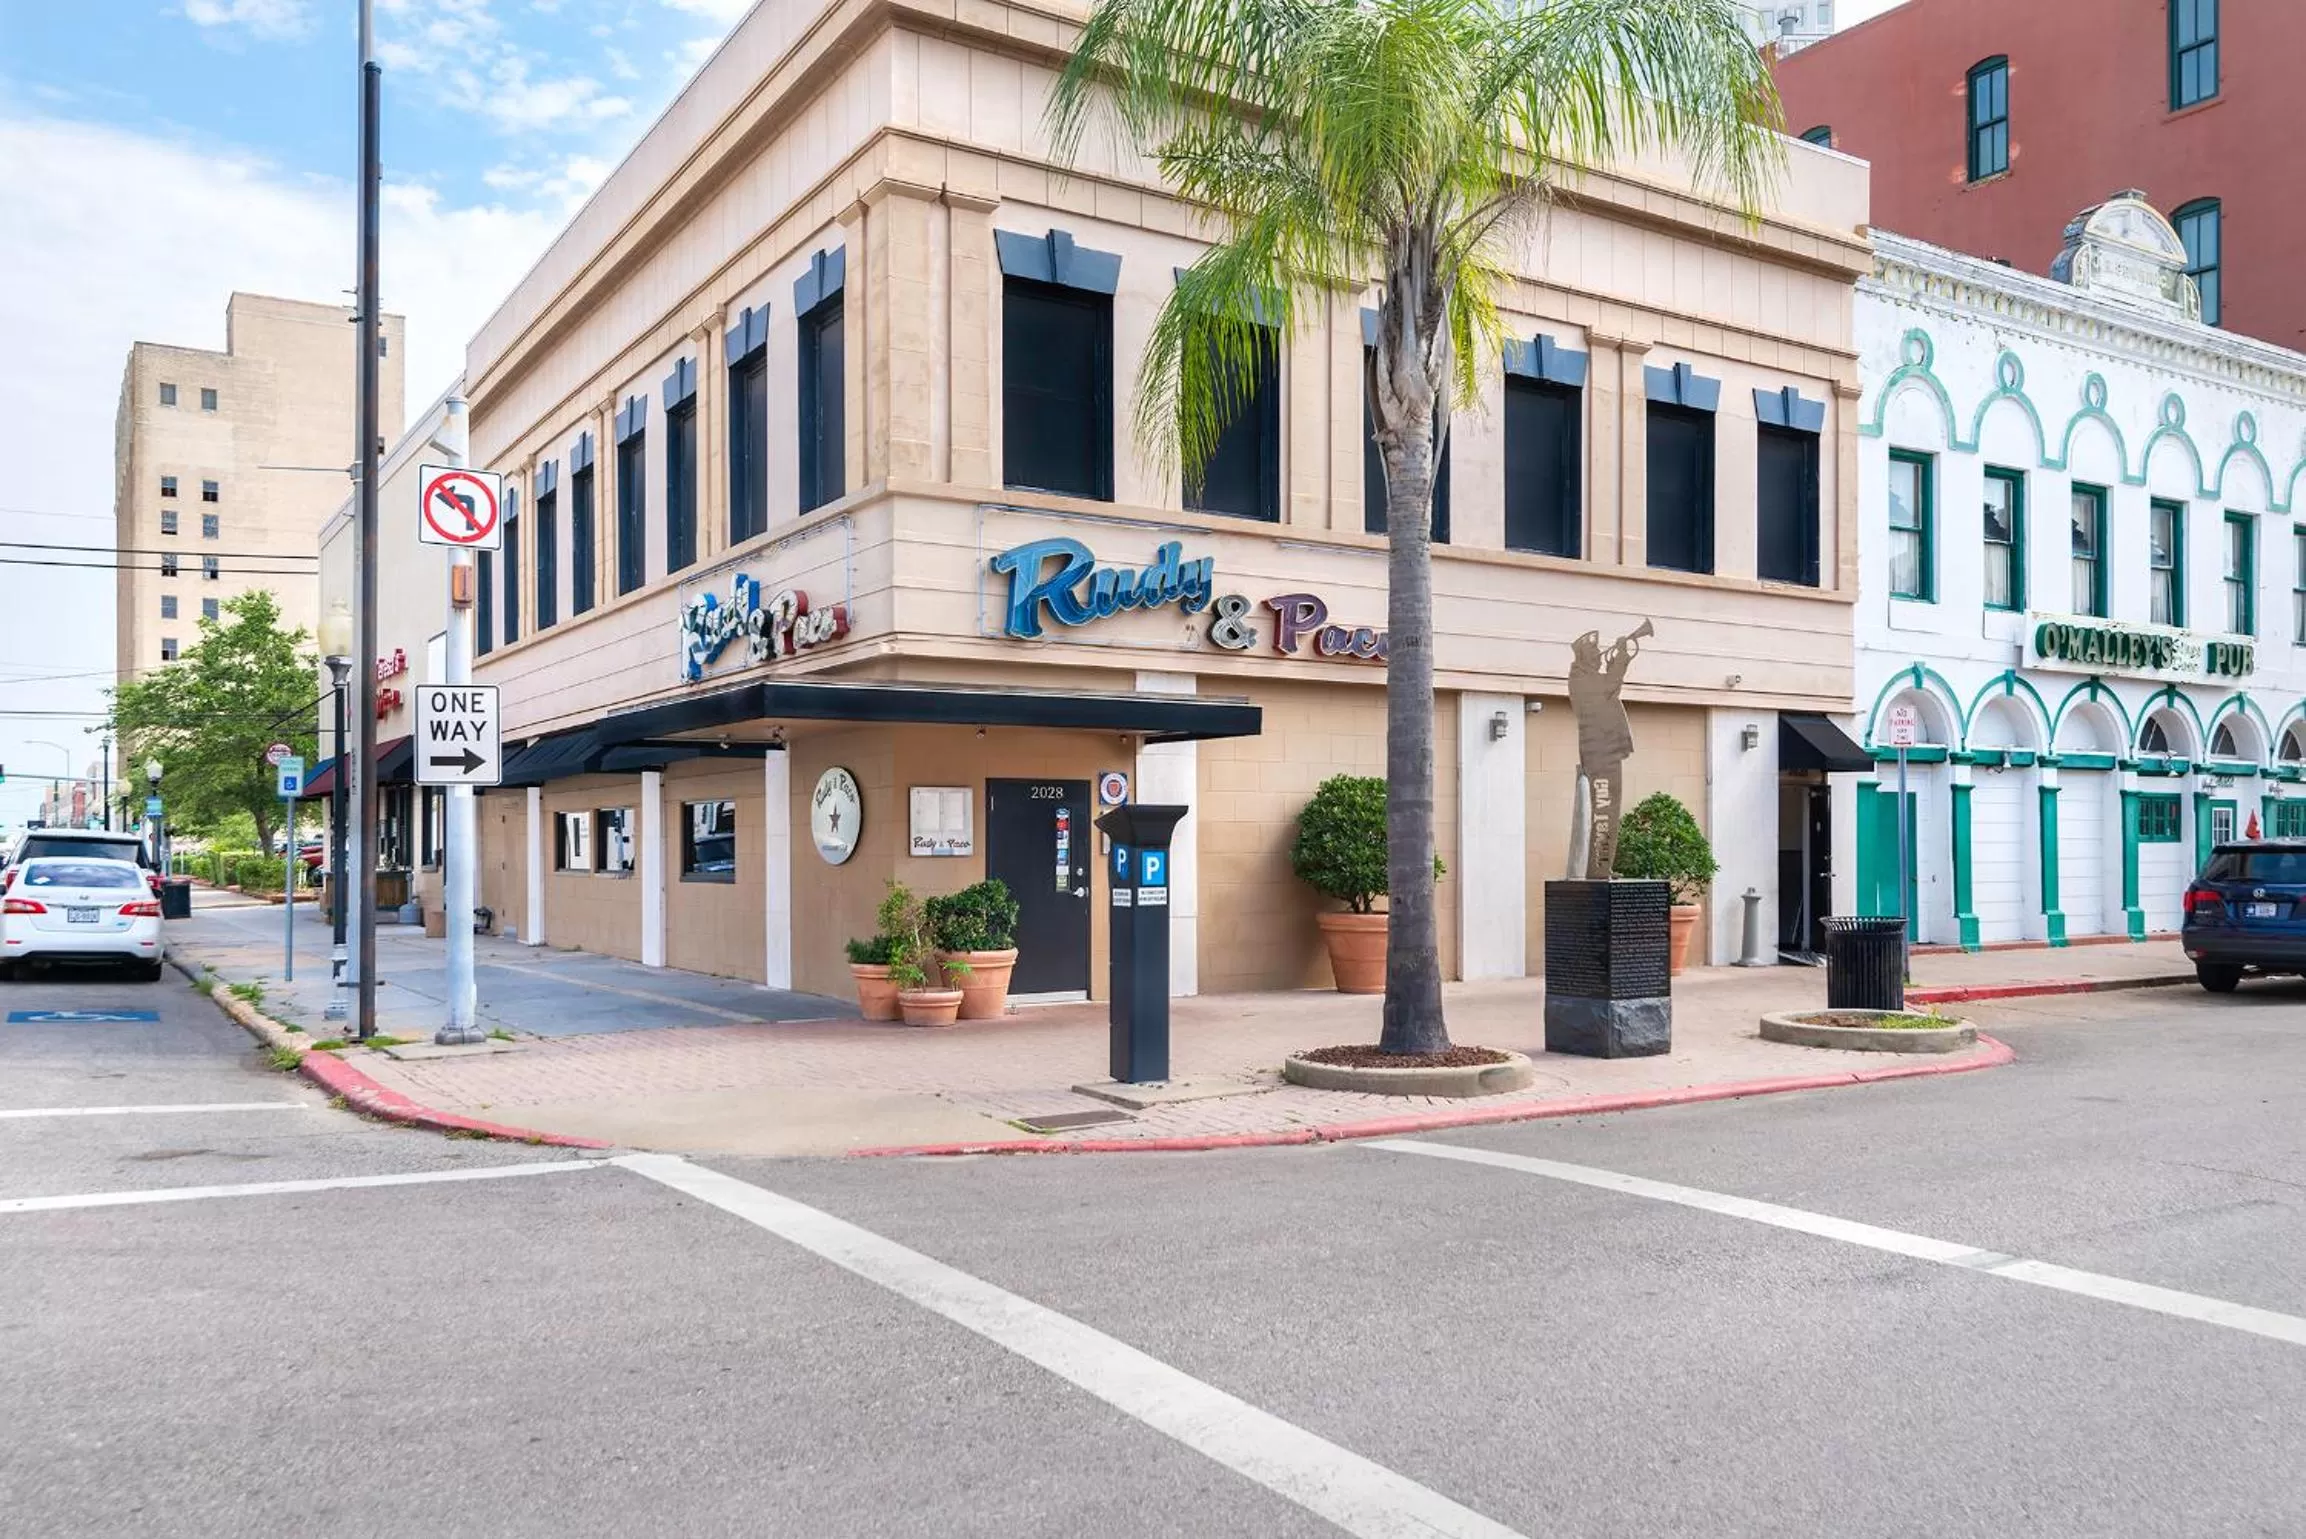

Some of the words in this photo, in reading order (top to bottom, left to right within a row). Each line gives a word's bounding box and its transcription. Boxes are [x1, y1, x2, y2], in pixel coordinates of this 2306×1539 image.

[990, 537, 1215, 638] Rudy
[1206, 594, 1257, 651] &
[680, 573, 760, 684] Rudy
[769, 589, 849, 656] Paco
[2036, 623, 2172, 669] O'MALLEY'S
[2208, 642, 2254, 676] PUB
[431, 692, 485, 713] ONE
[430, 720, 488, 742] WAY
[1031, 786, 1064, 799] 2028
[913, 836, 937, 852] Rudy
[1117, 848, 1127, 873] P
[1146, 857, 1160, 881] P
